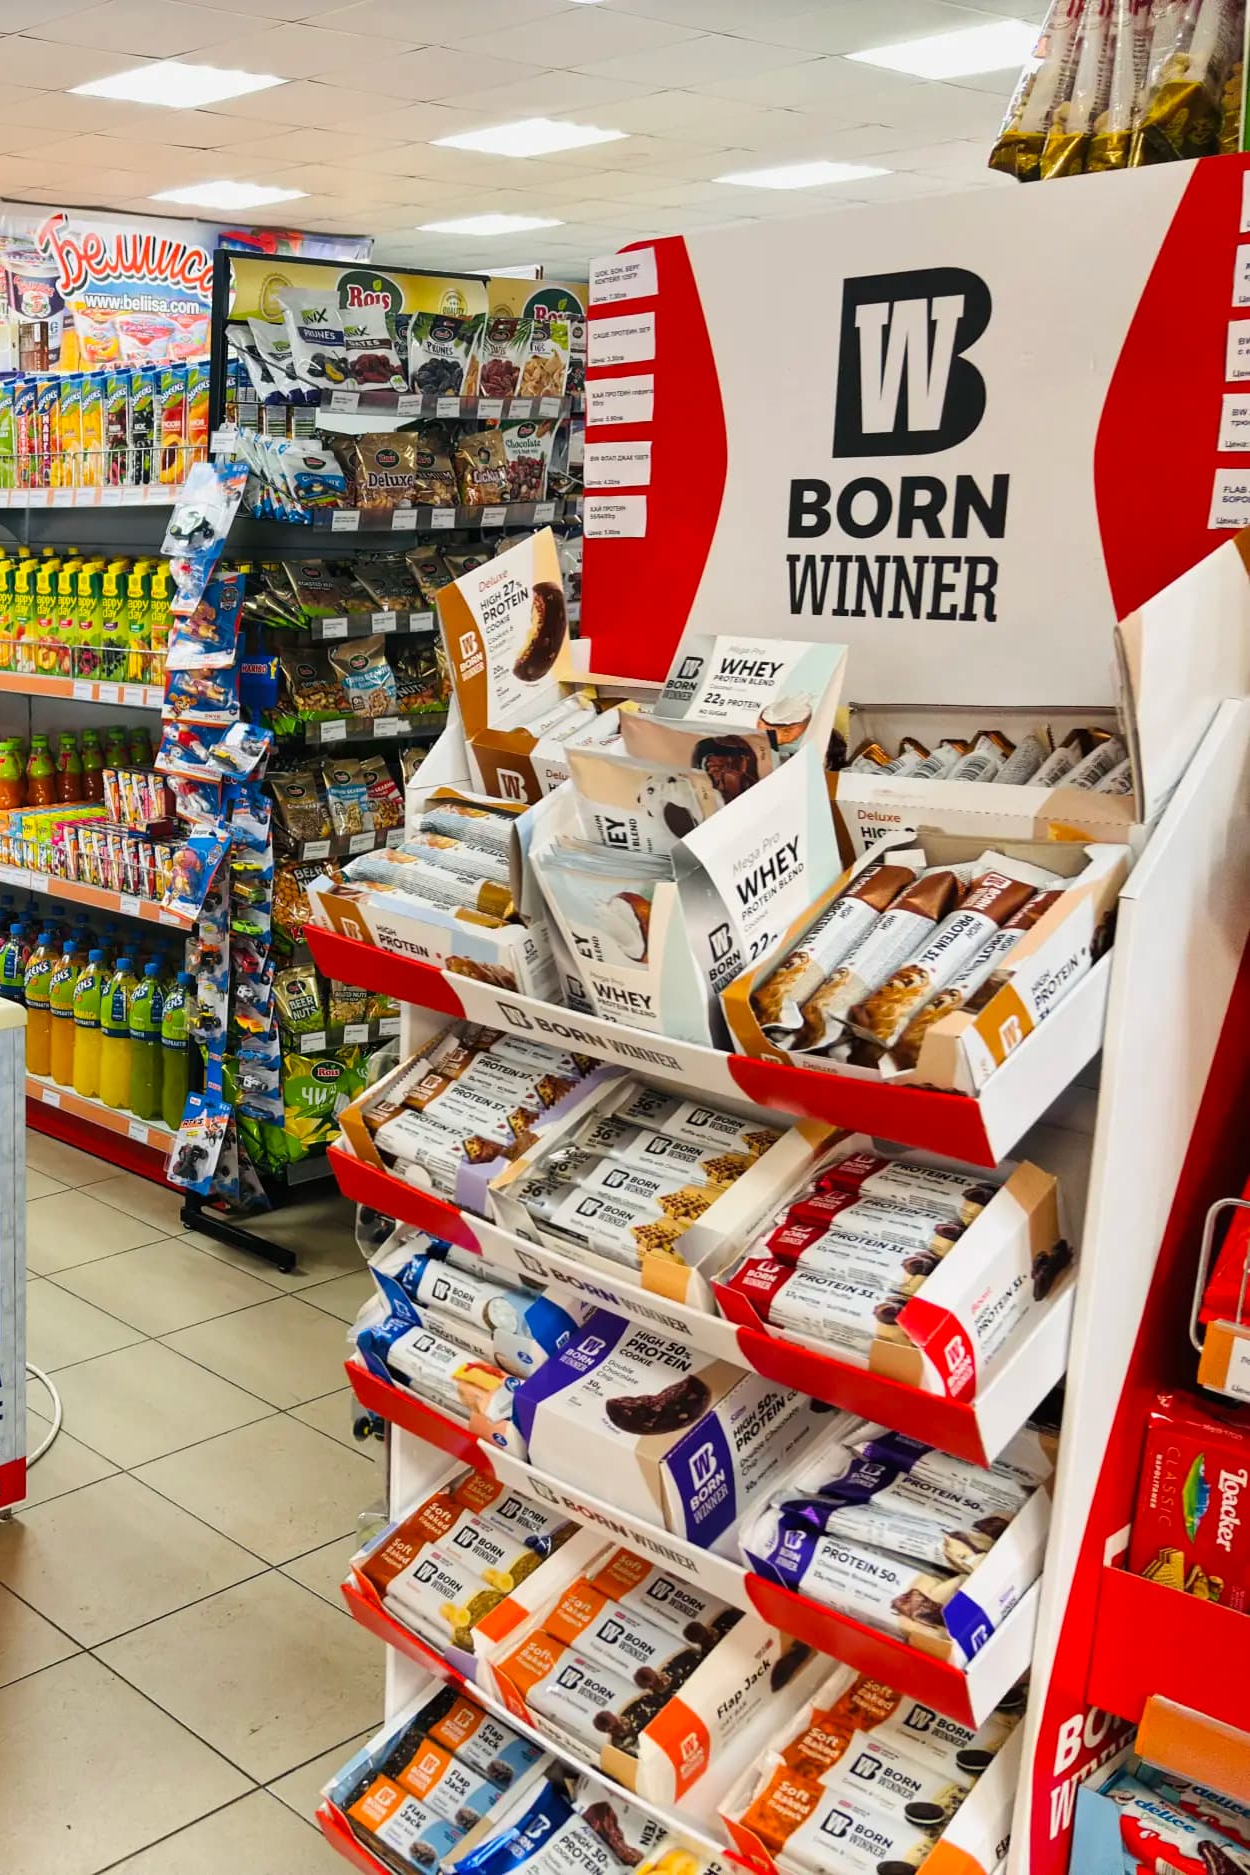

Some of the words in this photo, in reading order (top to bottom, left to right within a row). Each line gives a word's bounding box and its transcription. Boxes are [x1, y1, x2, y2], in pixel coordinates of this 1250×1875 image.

[302, 328, 337, 342] PRUNES
[367, 471, 415, 489] Deluxe
[787, 473, 1010, 539] BORN
[786, 553, 1000, 623] WINNER
[480, 591, 501, 611] HIGH
[482, 588, 529, 624] PROTEIN
[241, 663, 268, 674] HARIBO
[720, 657, 784, 679] WHEY
[665, 679, 698, 692] BORN
[713, 674, 748, 686] PROTEIN
[748, 676, 775, 687] BLEND
[703, 693, 727, 707] 22g
[727, 698, 761, 710] PROTEIN
[857, 809, 901, 824] Deluxe
[762, 831, 781, 853] Pro
[736, 835, 800, 906] WHEY
[741, 885, 779, 922] PROTEIN
[776, 862, 805, 890] BLEND
[974, 887, 1000, 911] BORN
[378, 933, 430, 958] PROTEIN
[936, 914, 974, 955] PROTEIN
[708, 951, 742, 981] BORN
[289, 996, 315, 1011] BEER
[591, 981, 652, 1010] WHEY
[292, 1006, 318, 1022] NUTS
[534, 1016, 608, 1050] BORN
[605, 1037, 684, 1072] WINNER
[317, 1067, 340, 1078] Rois
[477, 1058, 520, 1080] PROTEIN
[451, 1086, 492, 1108] PROTEIN
[407, 1110, 449, 1132] PROTEIN
[707, 1121, 739, 1136] WINNER
[712, 1113, 746, 1129] BORN
[667, 1149, 698, 1164] WINNER
[672, 1141, 704, 1158] BORN
[629, 1174, 661, 1192] BORN
[892, 1162, 950, 1184] PROTEIN
[603, 1204, 635, 1222] BORN
[862, 1197, 922, 1218] PROTEIN
[597, 1212, 627, 1229] WINNER
[782, 1225, 811, 1241] BORN
[829, 1229, 888, 1251] PROTEIN
[549, 1267, 620, 1305] BORN
[745, 1267, 778, 1283] BORN
[797, 1271, 859, 1294] PROTEIN
[452, 1286, 475, 1304] BORN
[435, 1342, 458, 1358] BORN
[633, 1330, 667, 1348] HIGH
[558, 1355, 590, 1373] WINNER
[564, 1349, 597, 1367] BORN
[619, 1349, 655, 1368] COOKIE
[626, 1339, 692, 1373] PROTEIN
[733, 1412, 757, 1440] HIGH
[736, 1397, 786, 1452] PROTEIN
[690, 1468, 726, 1512] BORN
[901, 1475, 962, 1503] PROTEIN
[1157, 1446, 1181, 1527] CLASSIC
[429, 1501, 452, 1520] Soft
[520, 1506, 549, 1524] BORN
[693, 1483, 730, 1525] WINNER
[1215, 1468, 1248, 1552] Loacker
[423, 1509, 452, 1532] Baked
[560, 1496, 630, 1539] BORN
[630, 1526, 700, 1573] WINNER
[385, 1545, 412, 1566] Baked
[391, 1538, 414, 1555] Soft
[471, 1545, 499, 1566] WINNER
[477, 1537, 506, 1559] BORN
[821, 1545, 880, 1575] PROTEIN
[431, 1579, 456, 1601] WINNER
[437, 1571, 463, 1592] BORN
[673, 1590, 705, 1612] BORN
[526, 1641, 551, 1662] Soft
[617, 1641, 649, 1663] WINNER
[623, 1632, 656, 1657] BORN
[577, 1685, 609, 1708] WINNER
[583, 1678, 616, 1701] BORN
[716, 1689, 744, 1721] Flap
[743, 1658, 772, 1691] Jack
[483, 1724, 505, 1744] Flap
[808, 1727, 840, 1747] Soft
[930, 1726, 969, 1749] WINNER
[936, 1717, 976, 1742] BORN
[478, 1731, 501, 1751] Jack
[802, 1735, 840, 1759] Baked
[443, 1777, 468, 1798] Jack
[450, 1768, 471, 1790] Flap
[877, 1775, 916, 1801] WINNER
[883, 1766, 923, 1793] BORN
[772, 1789, 810, 1815] Baked
[778, 1780, 810, 1803] Soft
[399, 1810, 423, 1830] Jack
[406, 1803, 428, 1823] Flap
[1134, 1798, 1196, 1834] delice
[848, 1832, 888, 1860] WINNER
[854, 1823, 894, 1849] BORN
[558, 1835, 602, 1875] PROTEIN
